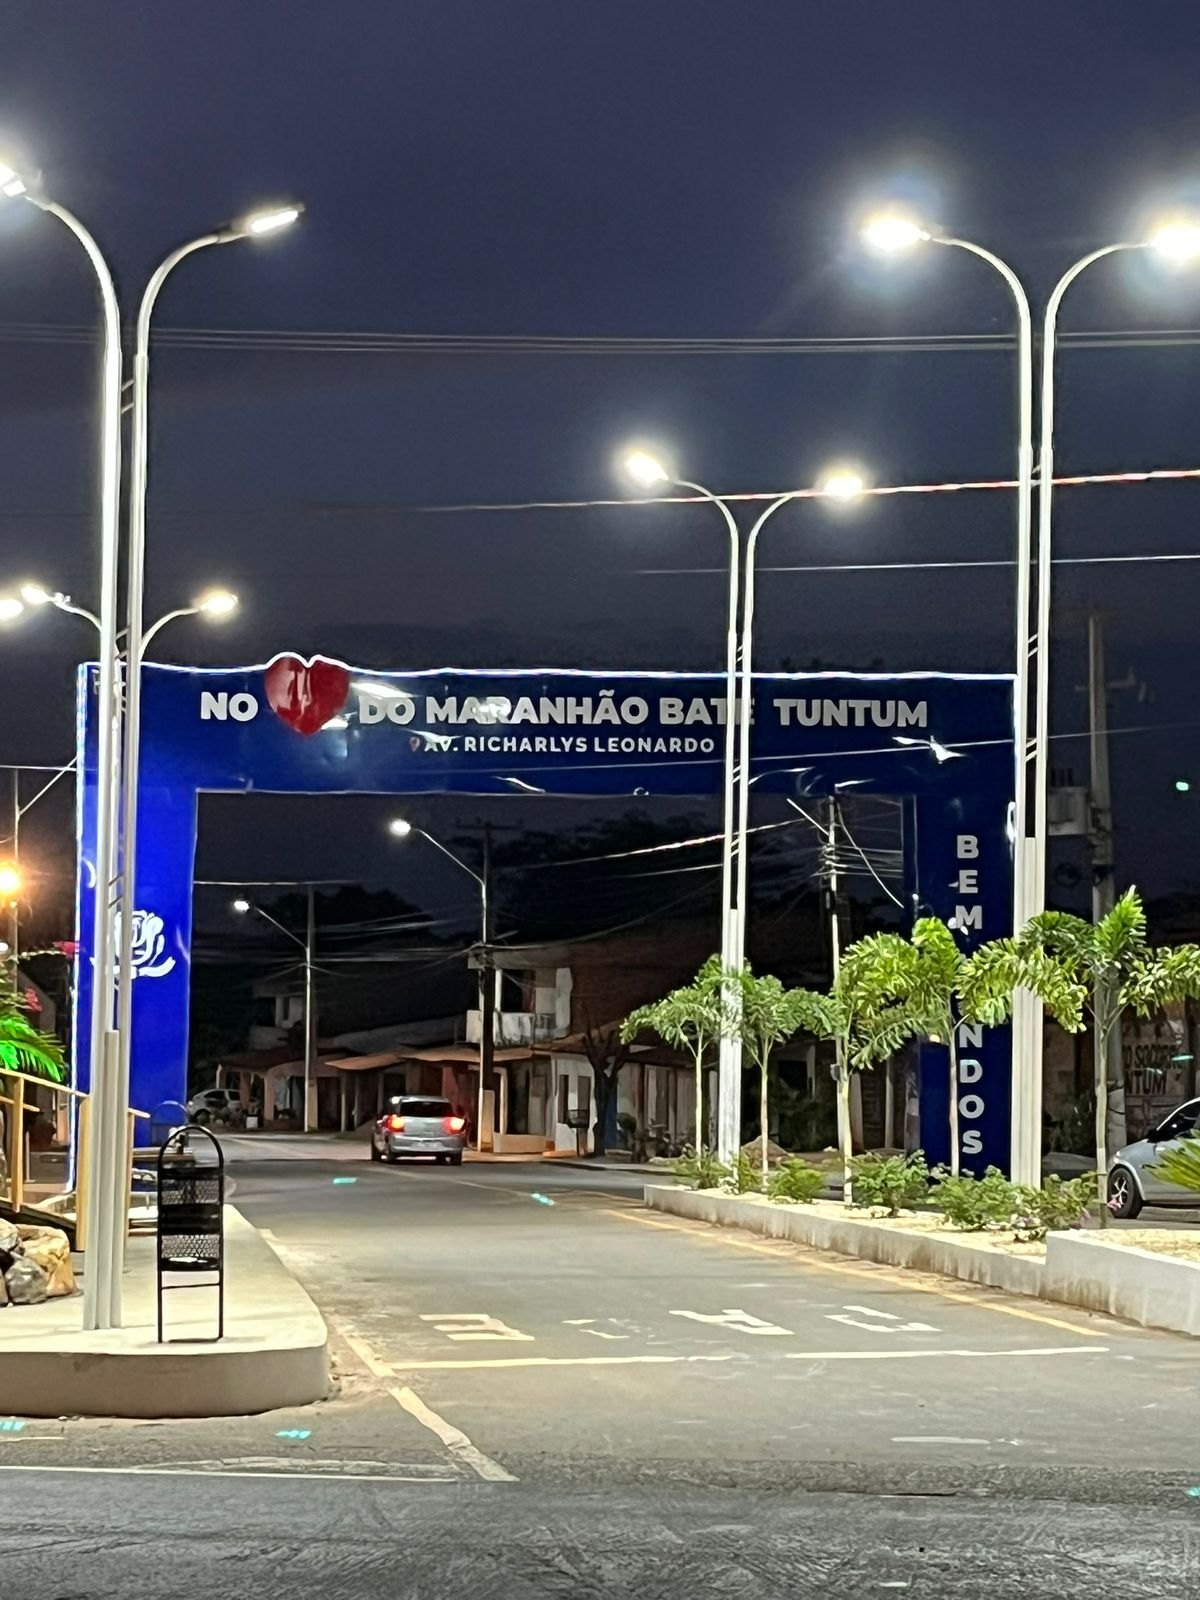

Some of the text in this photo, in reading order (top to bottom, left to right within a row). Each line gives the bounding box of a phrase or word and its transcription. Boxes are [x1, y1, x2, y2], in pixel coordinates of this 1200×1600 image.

[201, 691, 259, 722] NO
[358, 695, 416, 725] DO
[425, 689, 649, 725] MARANHÃO
[773, 698, 928, 728] TUNTUM
[424, 736, 715, 753] AV. RICHARLYS LEONARDO
[955, 834, 983, 930] BEM
